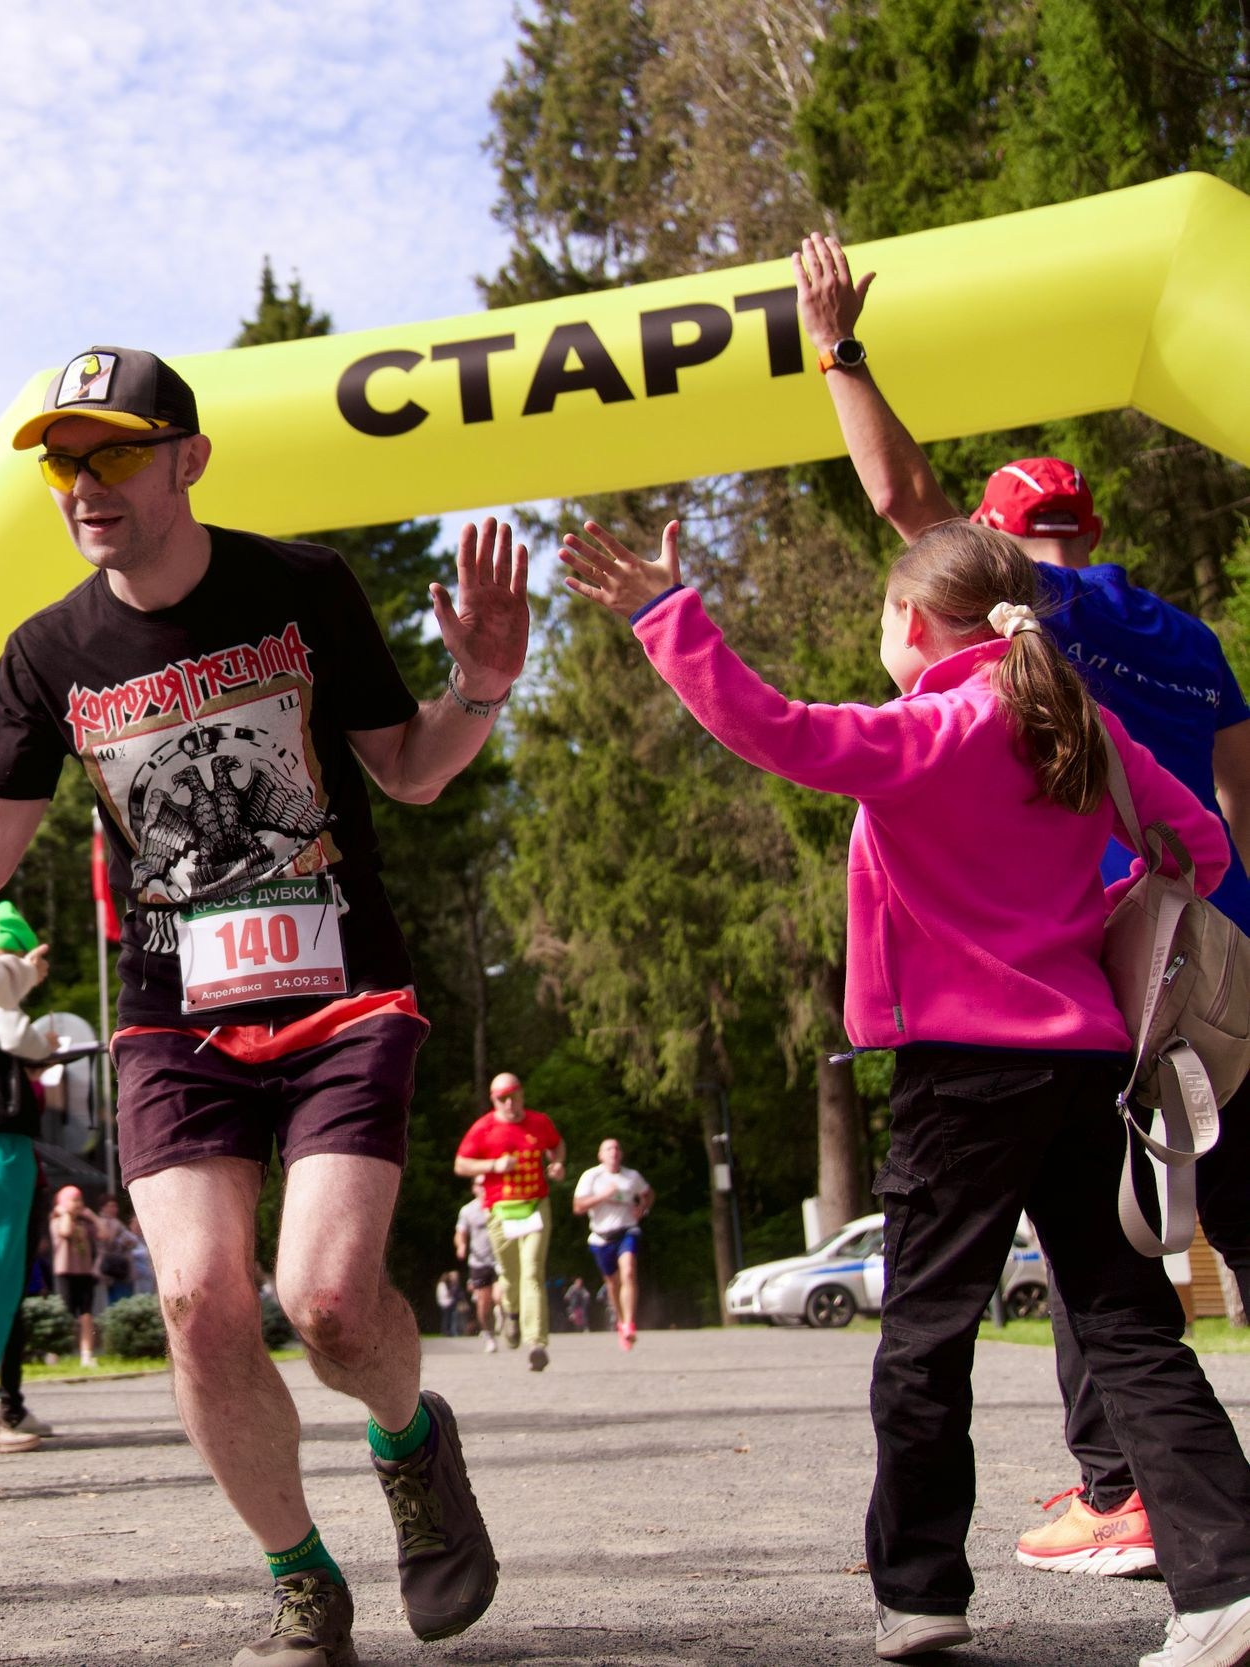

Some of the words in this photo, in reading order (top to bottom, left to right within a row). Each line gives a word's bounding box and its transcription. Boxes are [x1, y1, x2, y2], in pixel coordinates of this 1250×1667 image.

[336, 285, 805, 438] СТАРТ
[257, 886, 318, 905] ДУБКИ
[215, 913, 300, 971] 140
[201, 983, 262, 1001] Апрелевка
[273, 975, 330, 990] 14.09.25
[1092, 1520, 1130, 1543] HOKA
